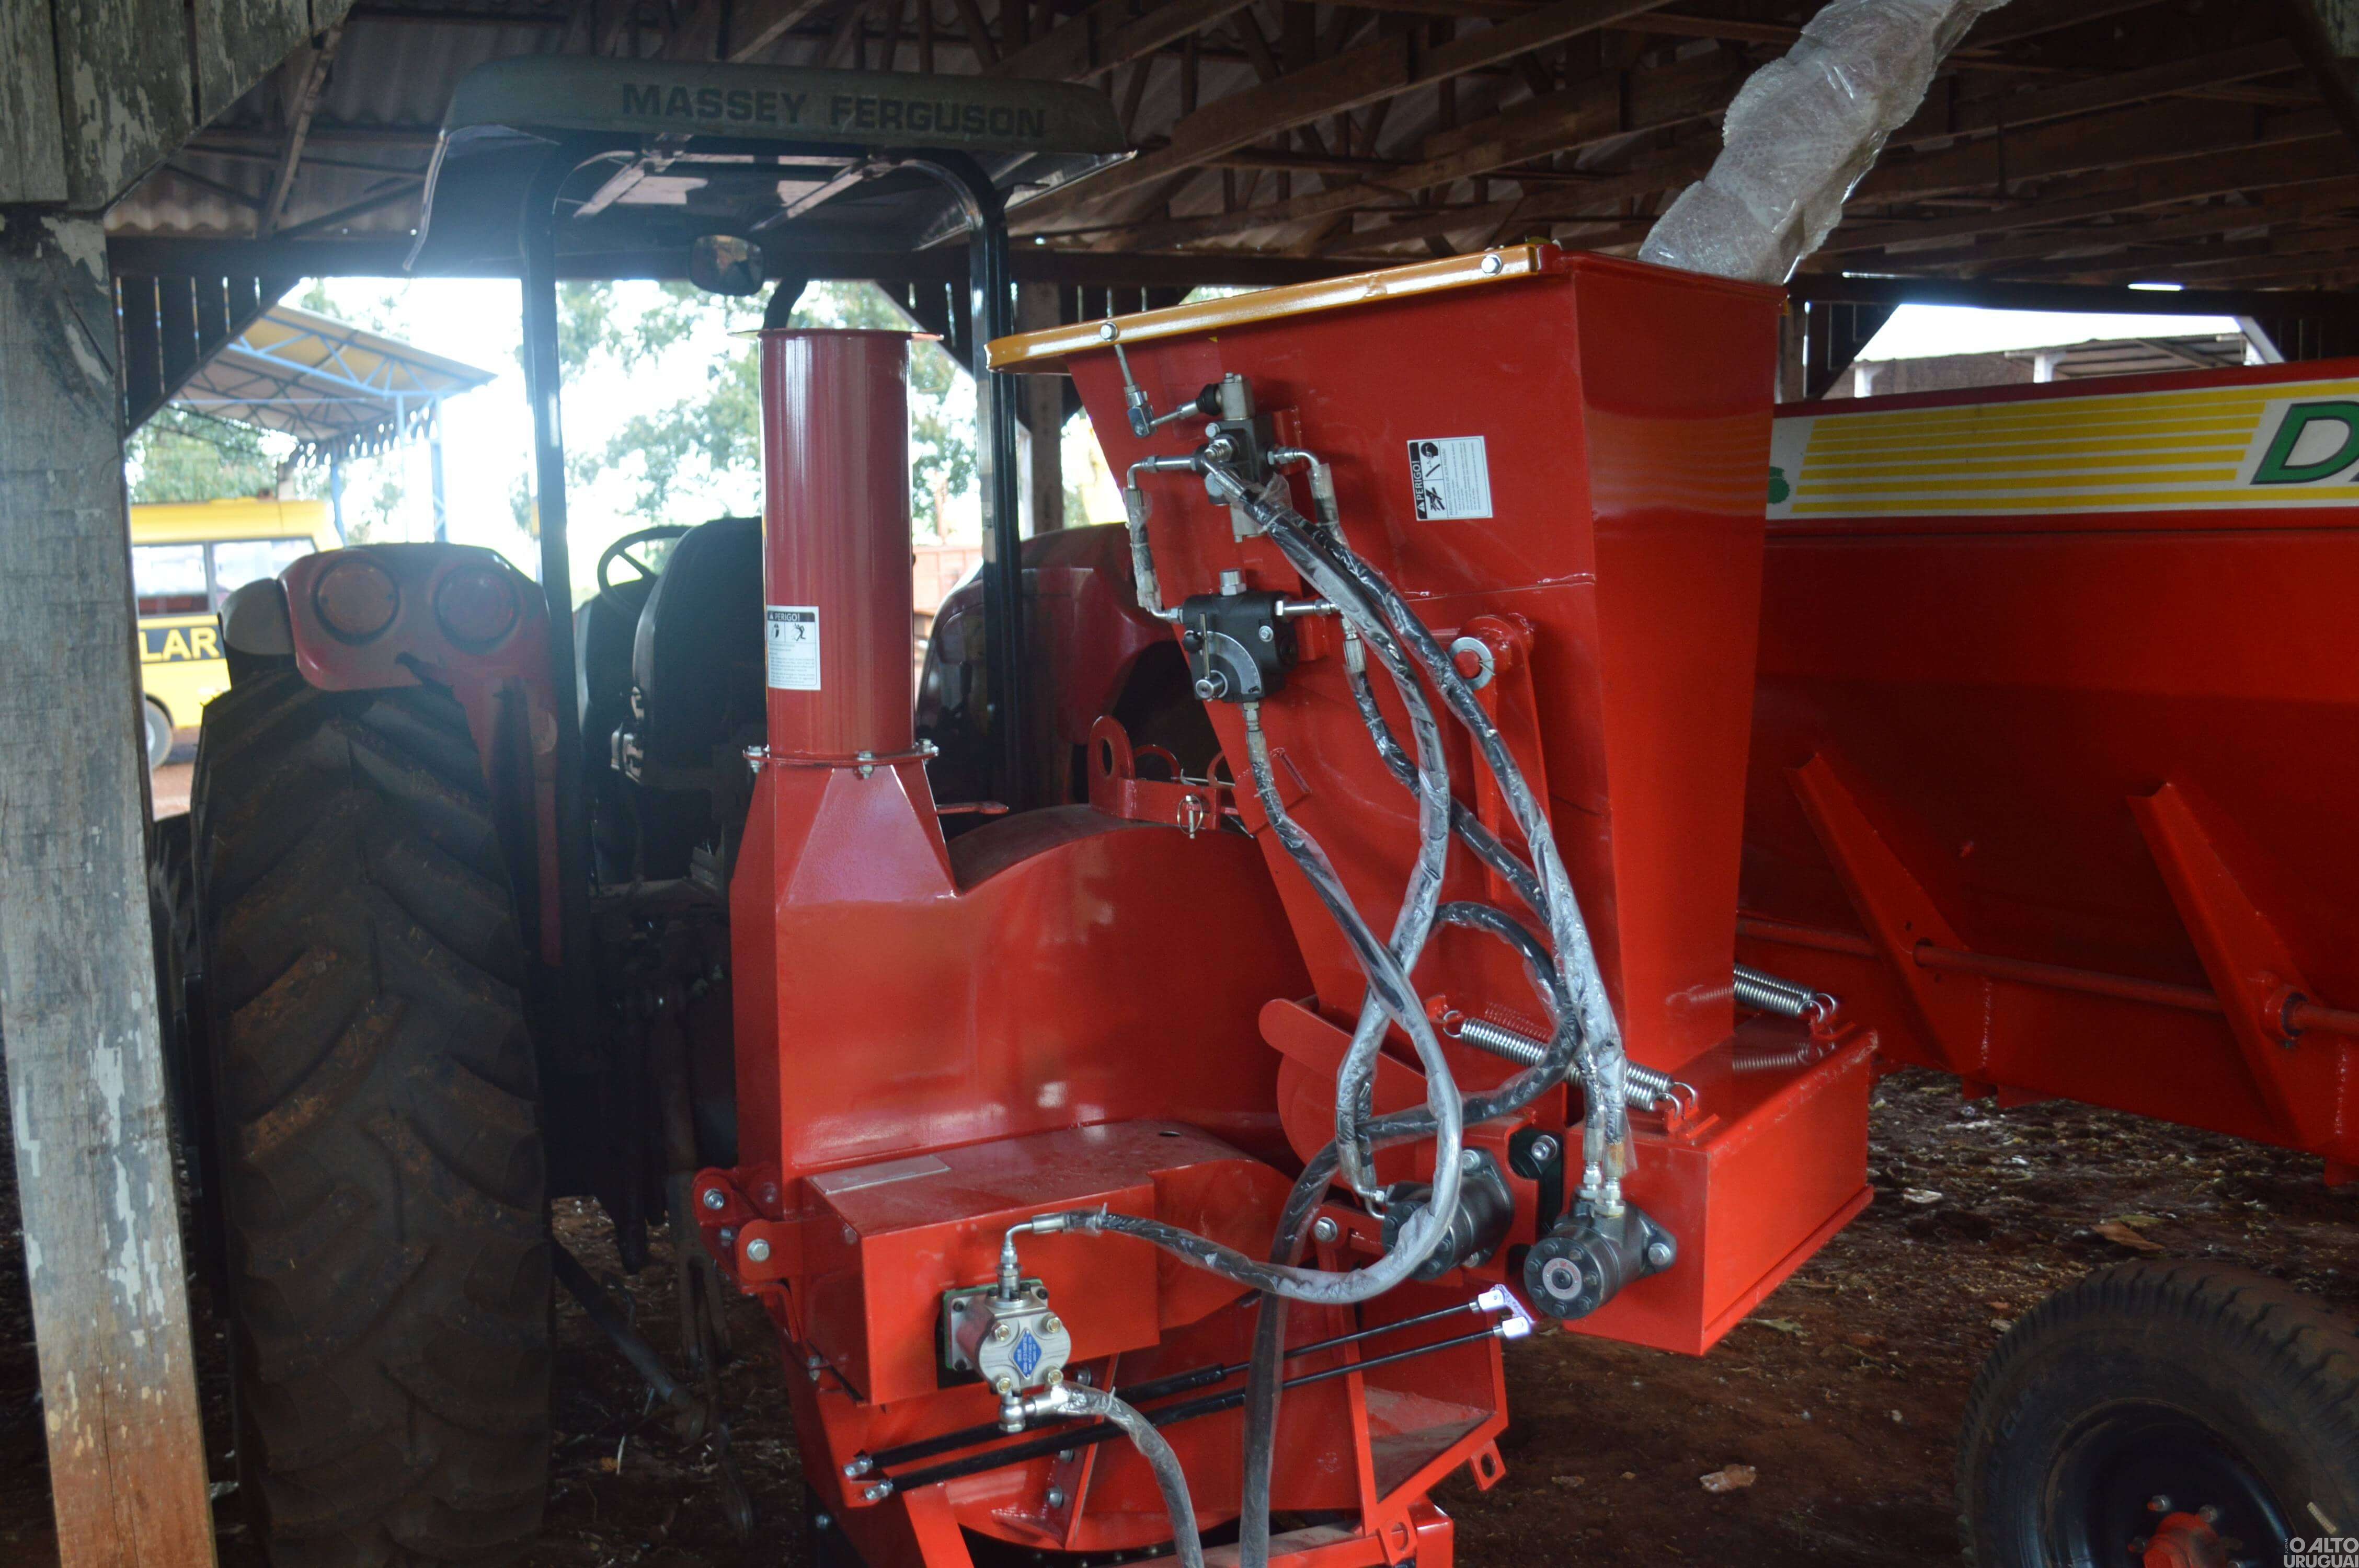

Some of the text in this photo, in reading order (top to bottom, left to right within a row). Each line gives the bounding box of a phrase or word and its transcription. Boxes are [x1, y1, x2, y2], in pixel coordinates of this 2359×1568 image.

[623, 84, 1045, 137] MASSEY FERGUSON
[2250, 400, 2359, 485] D
[1412, 460, 1425, 500] PERIGO!
[775, 612, 800, 621] PERIGO!
